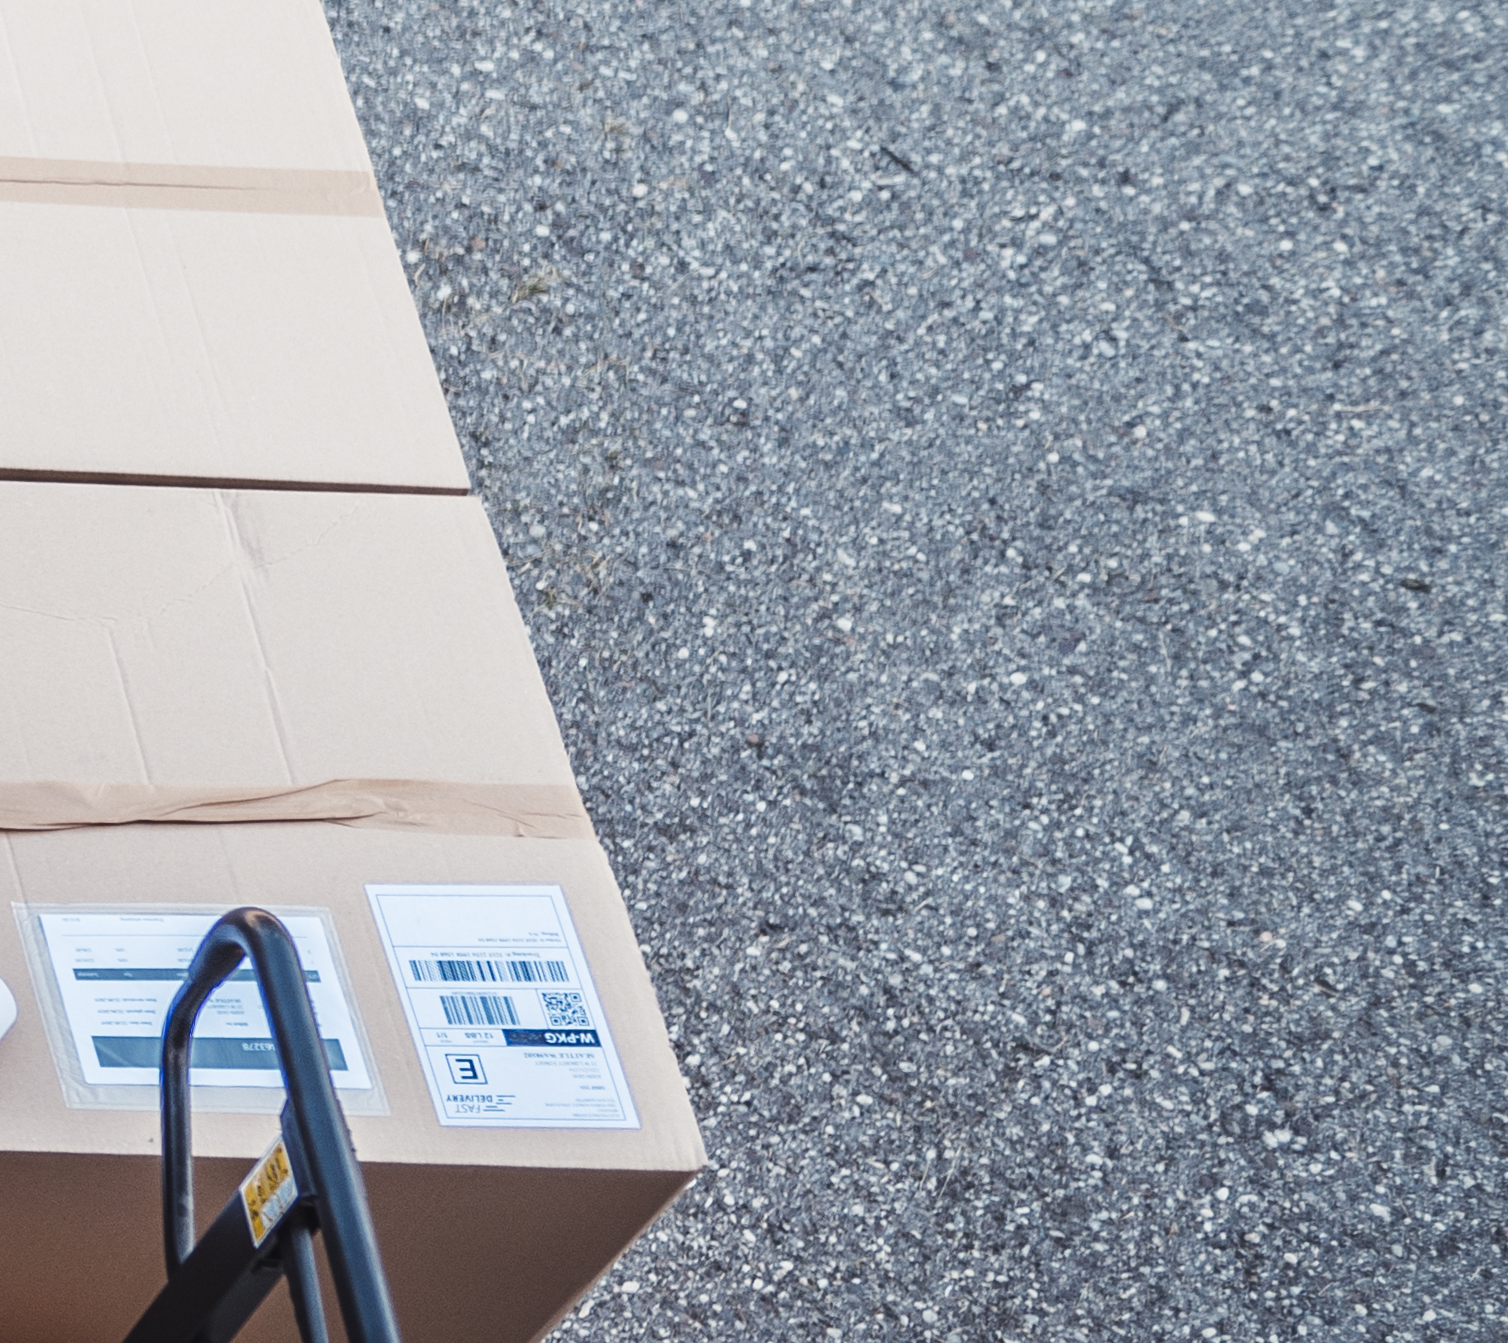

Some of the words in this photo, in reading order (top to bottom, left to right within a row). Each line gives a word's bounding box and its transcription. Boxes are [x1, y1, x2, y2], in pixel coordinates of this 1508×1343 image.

[483, 1031, 493, 1039] 12
[544, 1032, 594, 1043] W-PKG
[454, 1058, 479, 1080] E
[446, 1094, 493, 1103] DELIVERY
[454, 1103, 480, 1113] FAST
